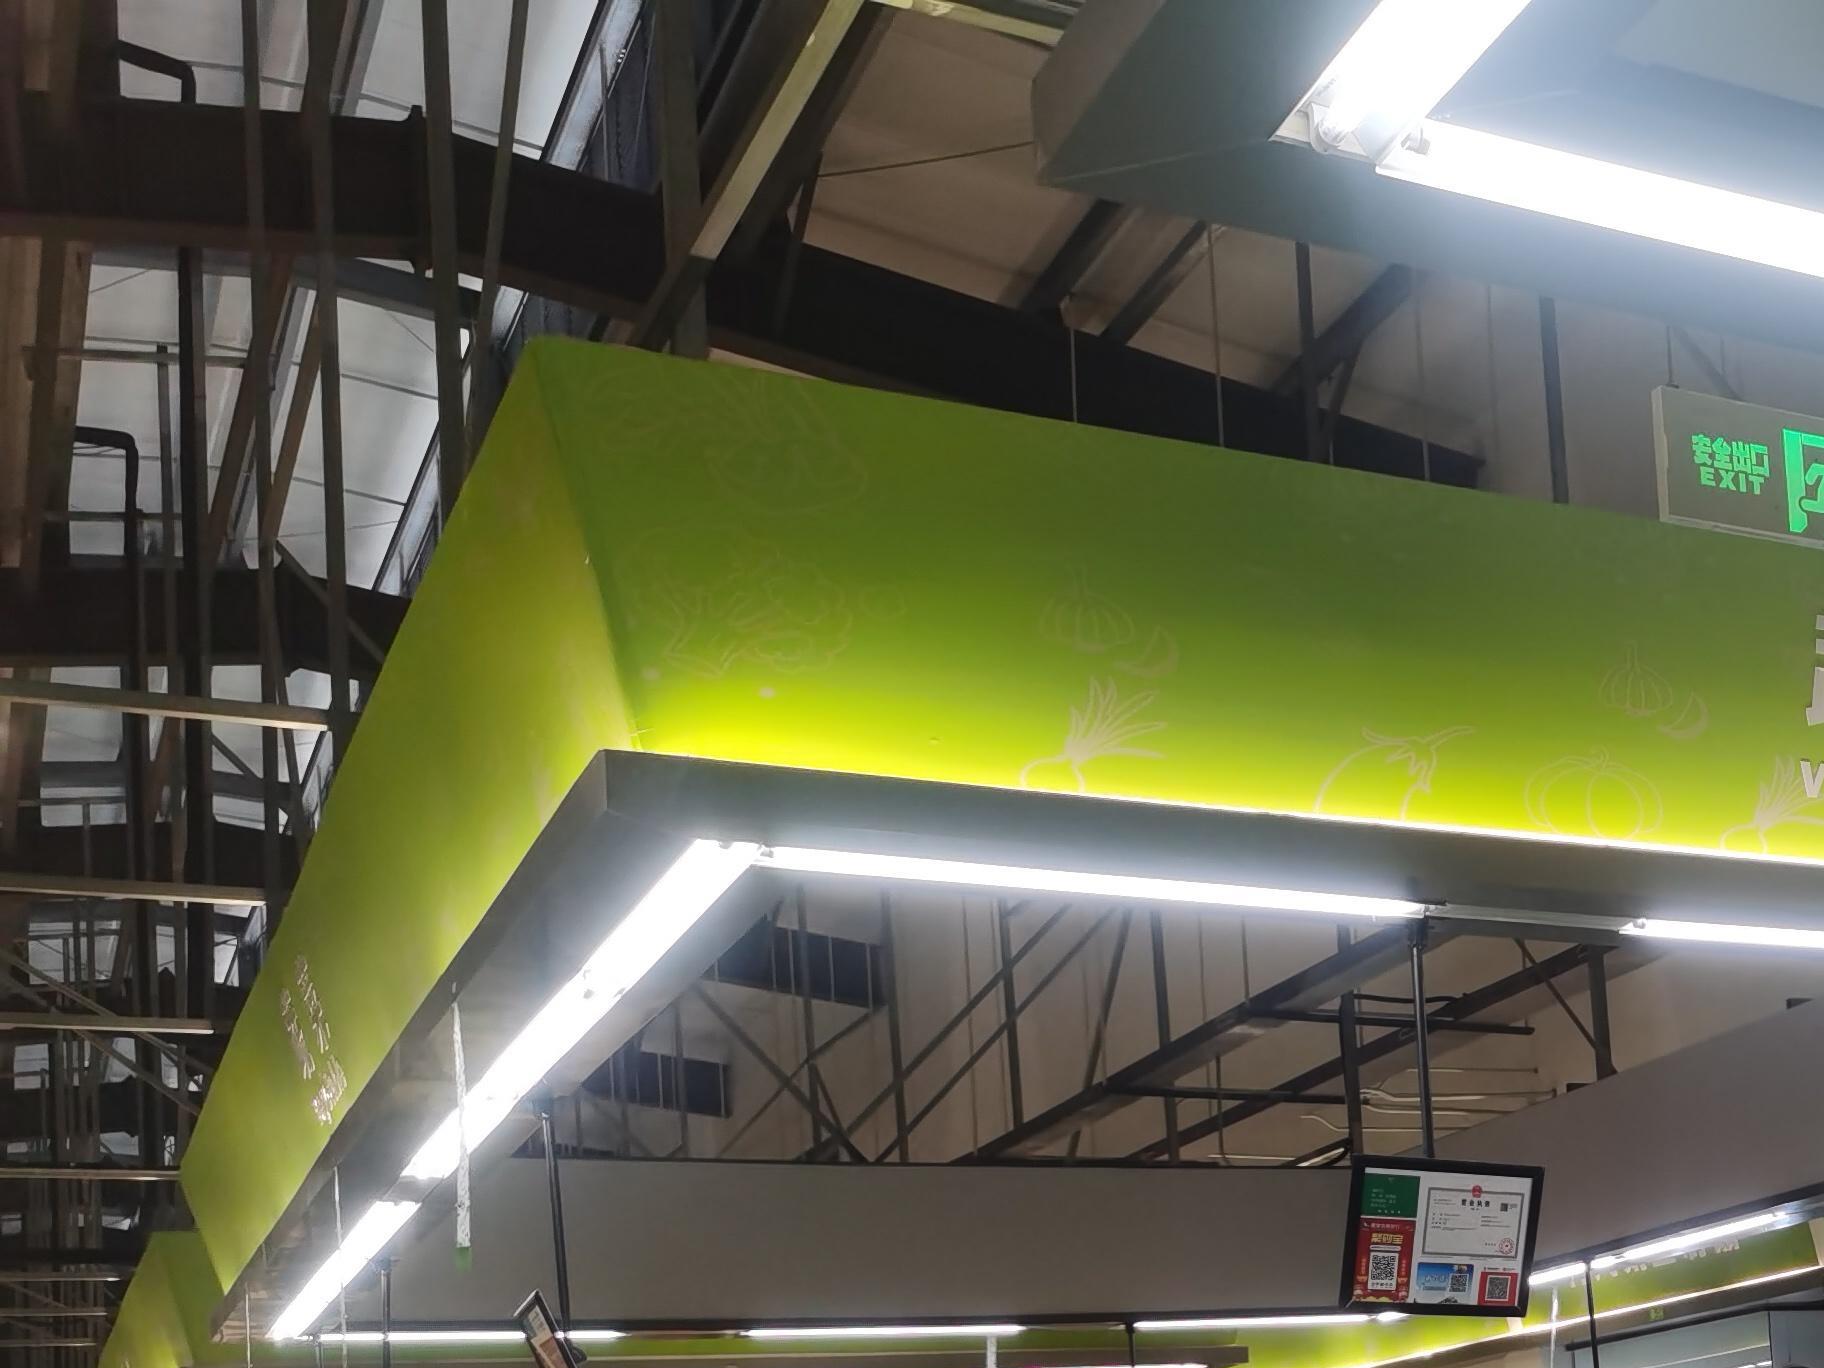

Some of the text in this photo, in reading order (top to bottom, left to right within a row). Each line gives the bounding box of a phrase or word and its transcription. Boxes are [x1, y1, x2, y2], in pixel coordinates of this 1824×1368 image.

[1691, 434, 1769, 477] 安全出口
[1700, 465, 1764, 495] EXIT
